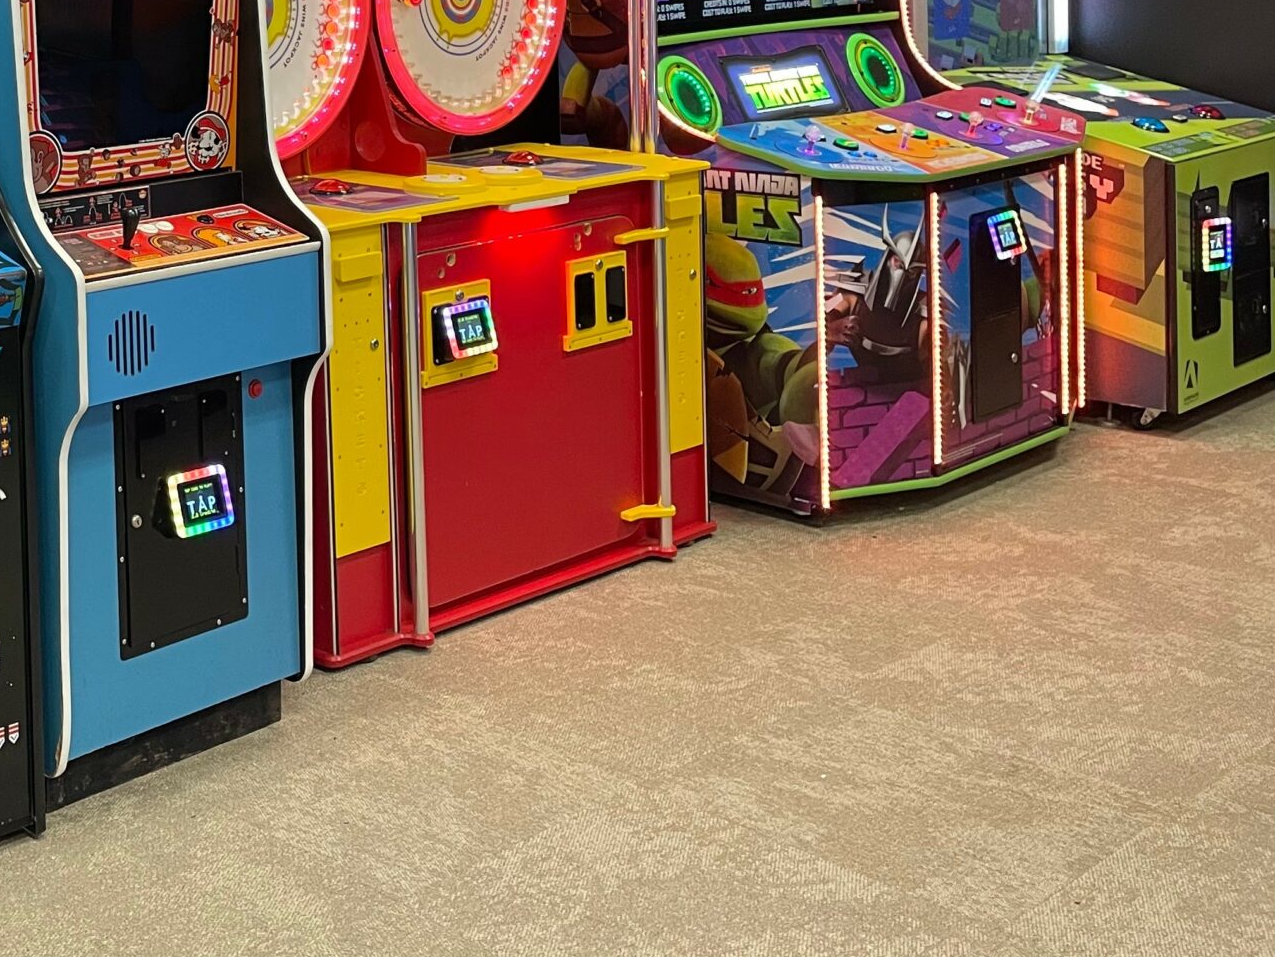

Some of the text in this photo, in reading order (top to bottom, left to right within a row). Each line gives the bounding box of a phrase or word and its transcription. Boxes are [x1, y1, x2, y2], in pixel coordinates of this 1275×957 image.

[734, 171, 800, 197] NINJA
[458, 324, 483, 341] TAP
[186, 495, 216, 517] TAP
